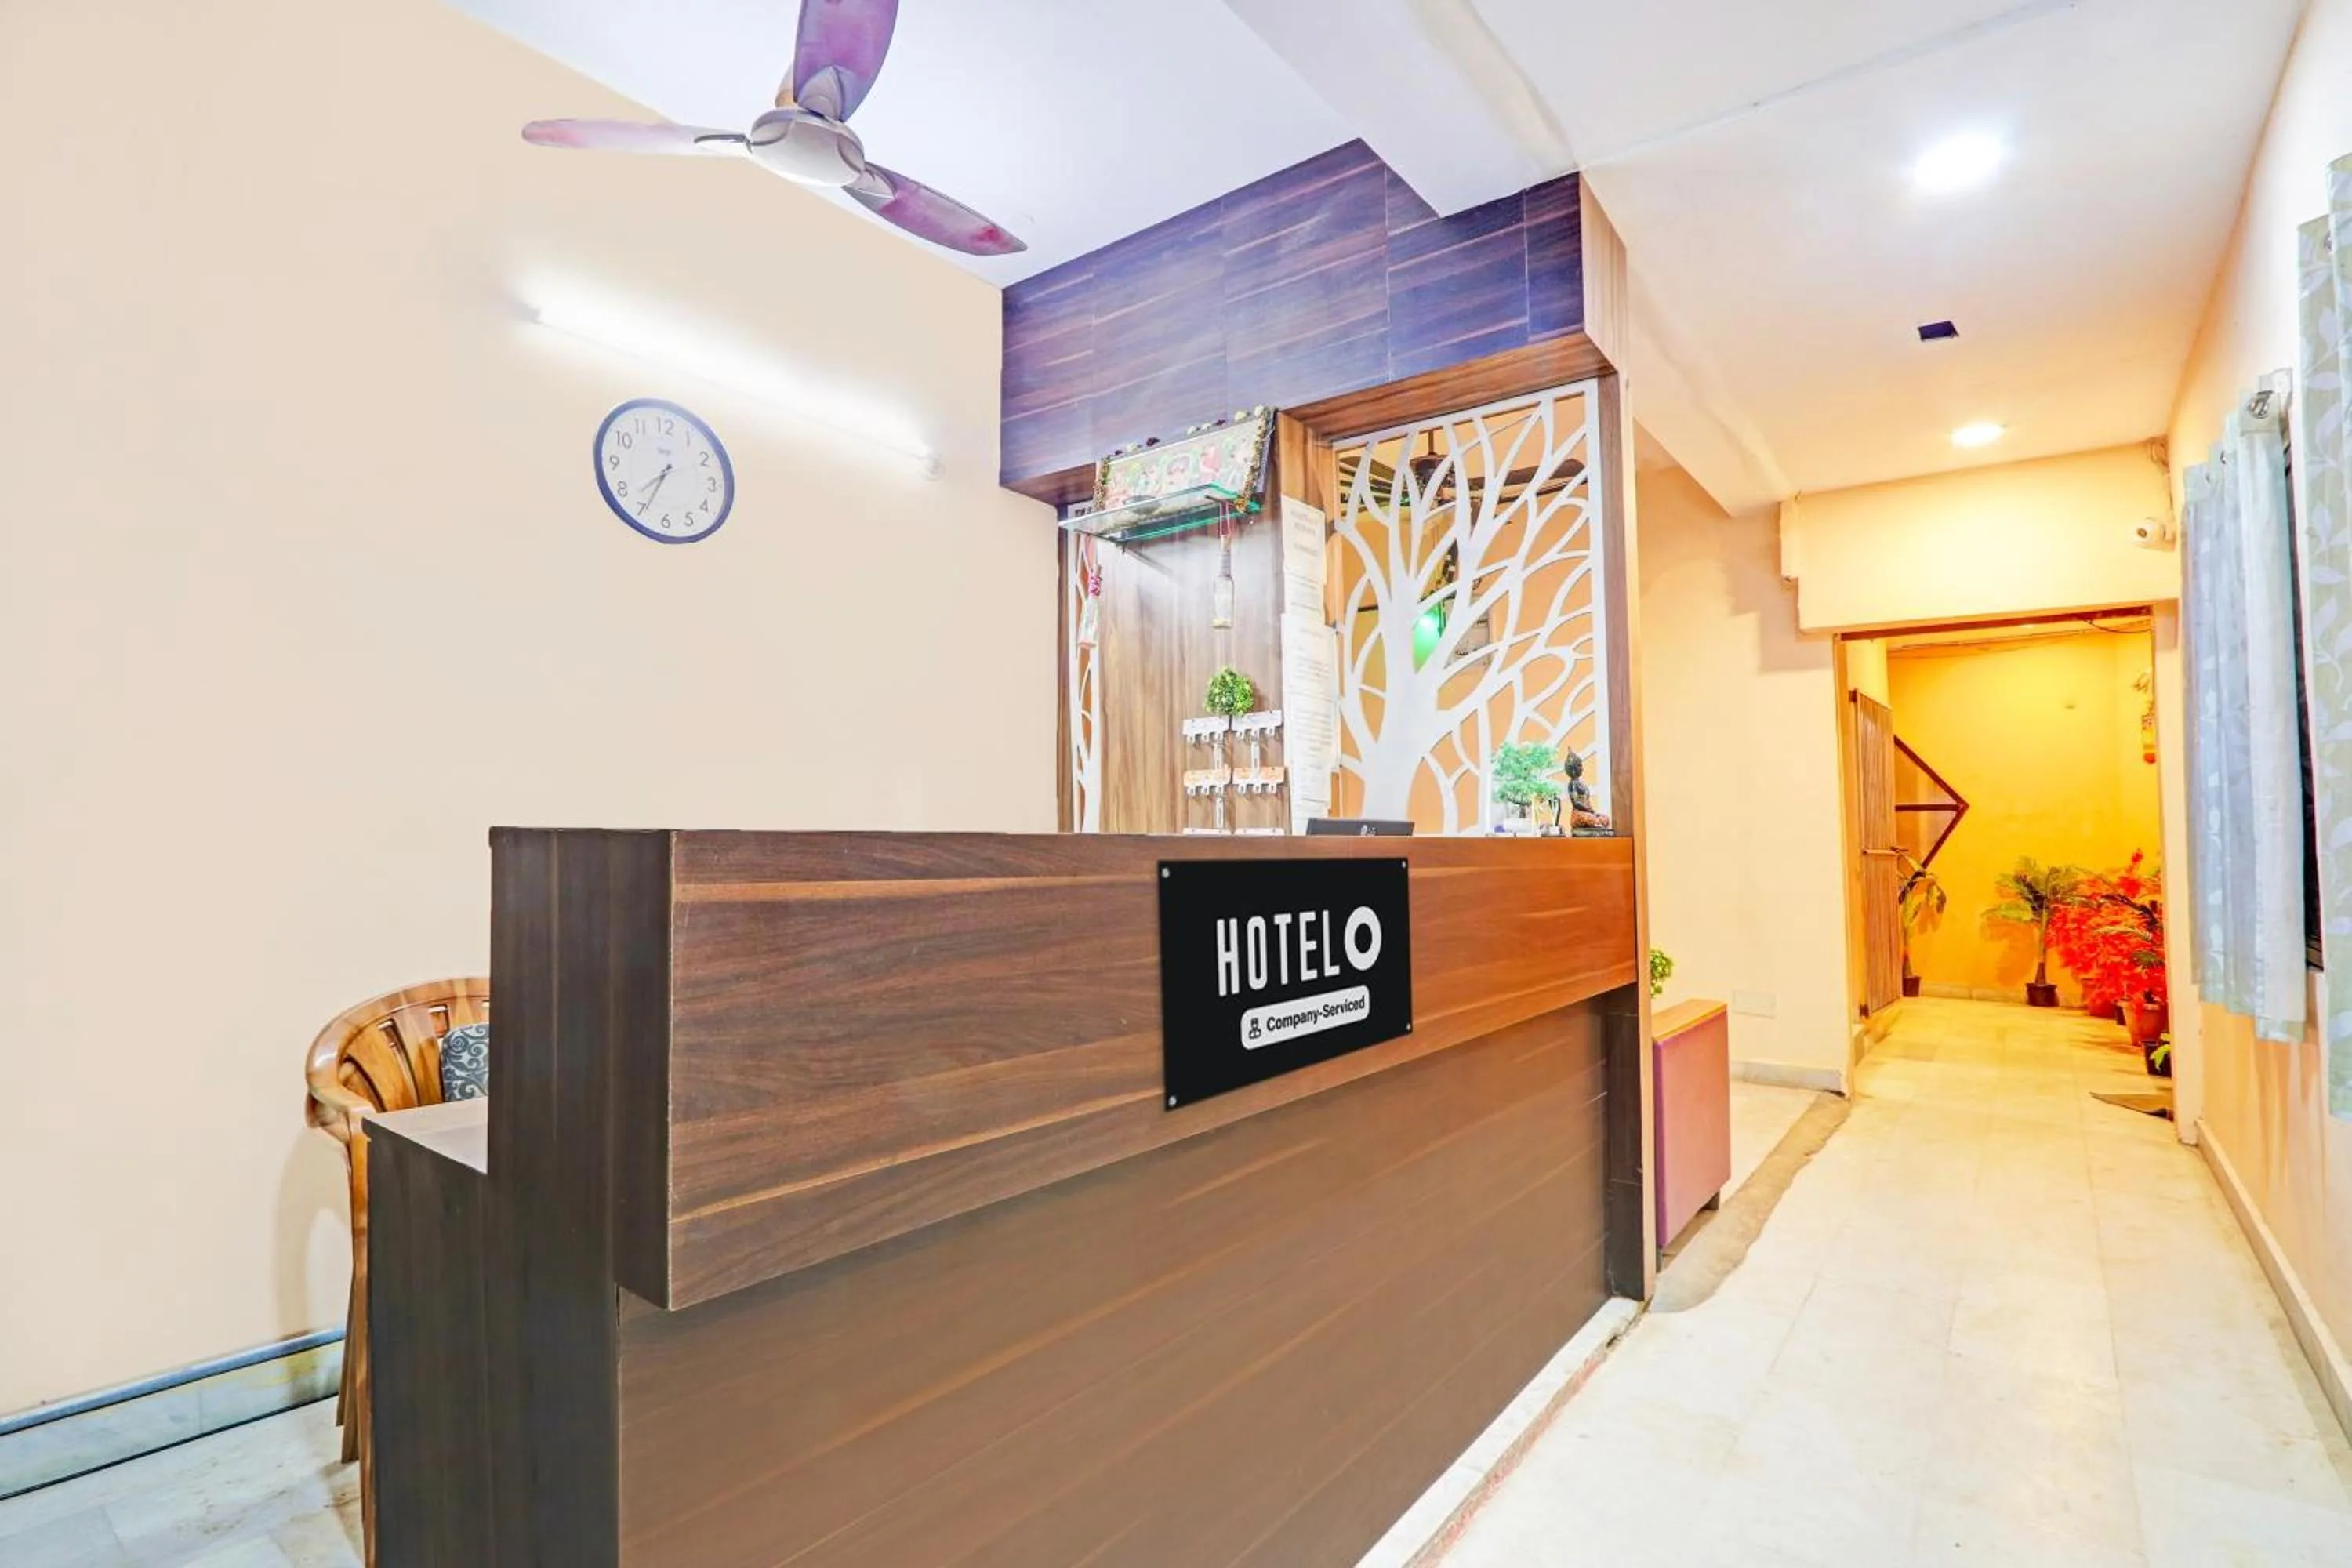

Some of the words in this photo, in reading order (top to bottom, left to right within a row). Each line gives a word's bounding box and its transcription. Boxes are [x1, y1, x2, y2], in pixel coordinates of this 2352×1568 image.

[657, 416, 675, 436] 12
[616, 430, 633, 449] 10
[609, 455, 620, 470] 9
[699, 451, 710, 466] 2
[616, 480, 628, 498] 8
[707, 477, 717, 493] 3
[636, 501, 647, 516] 7
[699, 499, 709, 513] 4
[661, 514, 671, 529] 6
[683, 512, 694, 527] 5
[1266, 995, 1365, 1029] Company-Serviced
